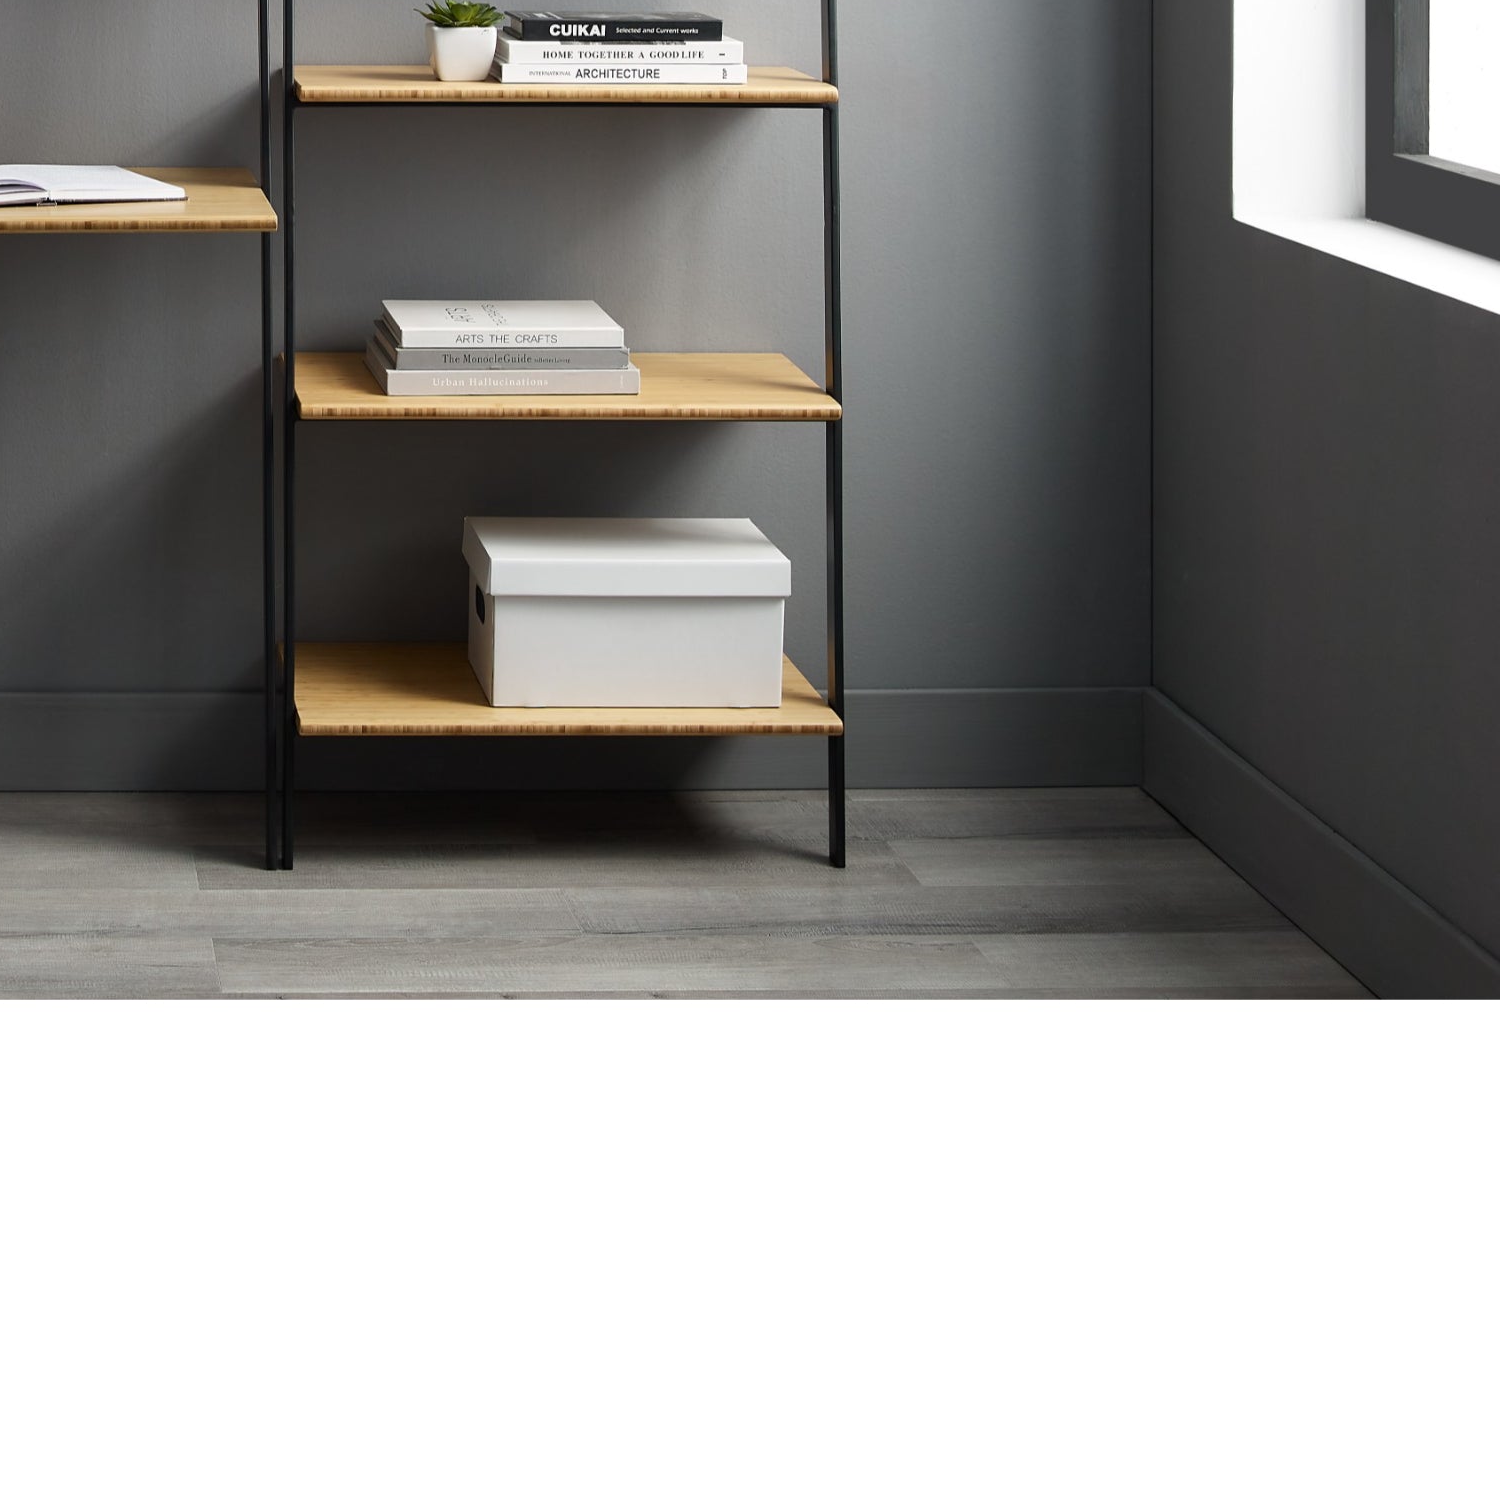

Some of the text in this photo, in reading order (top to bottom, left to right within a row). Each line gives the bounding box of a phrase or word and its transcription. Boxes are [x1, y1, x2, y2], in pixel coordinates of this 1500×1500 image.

[549, 23, 606, 37] CUIKAI
[542, 50, 705, 59] HOME TOGETHER A GOOD LIFE
[575, 68, 660, 79] ARCHITECTURE
[455, 334, 558, 344] ARTS THE CRAFTS
[442, 353, 460, 364] The
[432, 377, 549, 387] Urban Hallucinations
